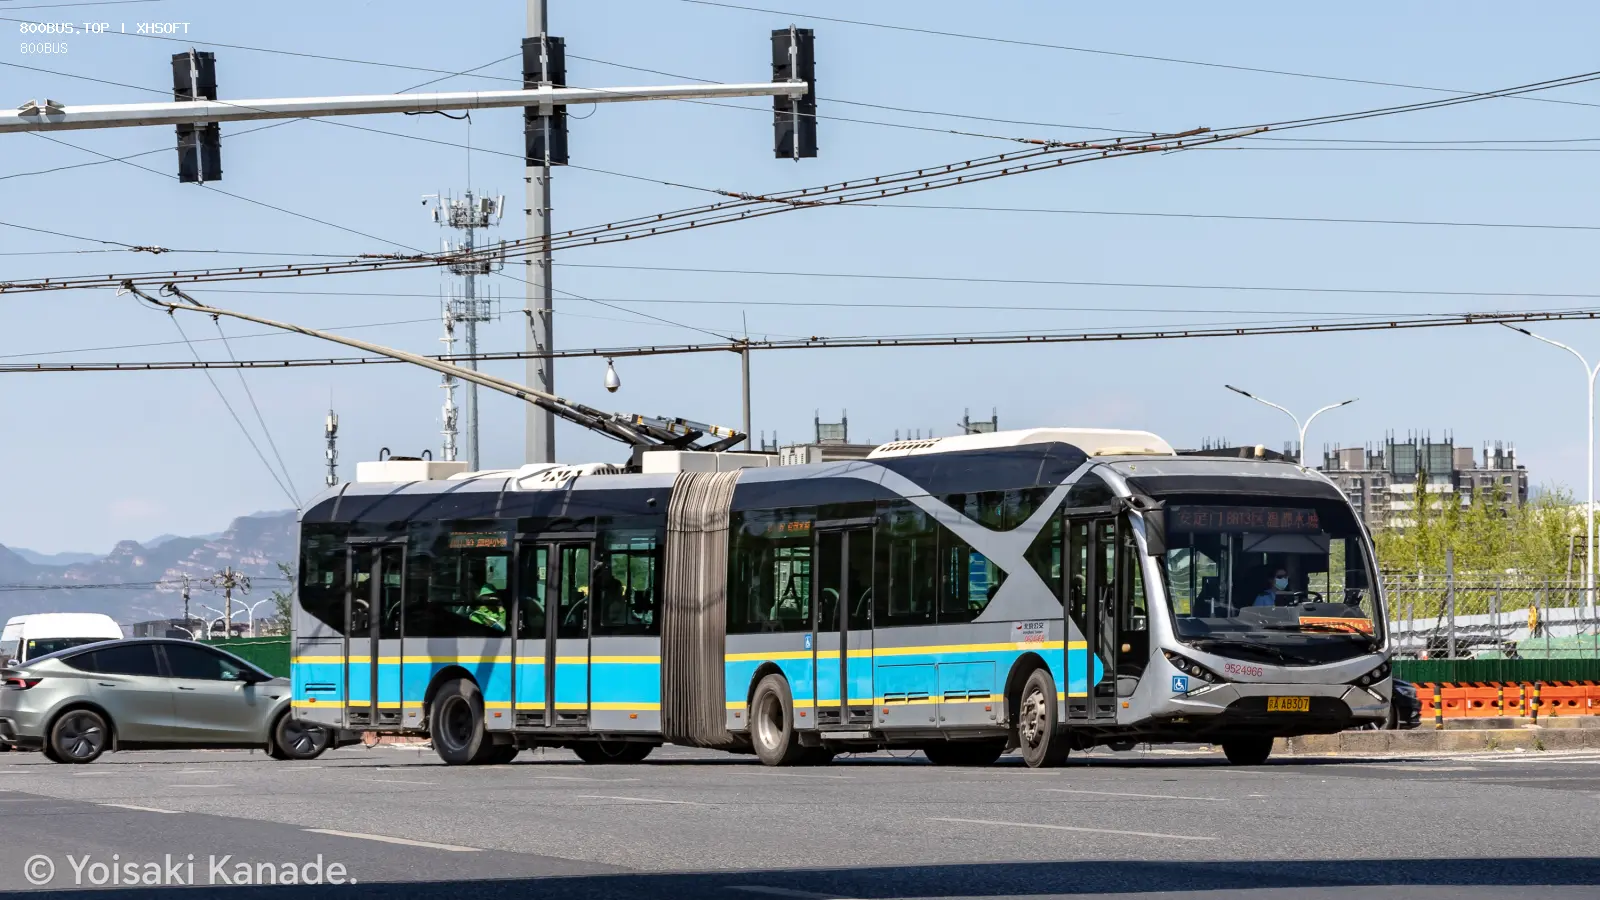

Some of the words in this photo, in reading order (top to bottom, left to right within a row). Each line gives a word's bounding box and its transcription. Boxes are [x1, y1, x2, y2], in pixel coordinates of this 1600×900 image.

[1178, 510, 1223, 528] 安定门
[1224, 663, 1263, 677] 9524966
[1281, 698, 1309, 710] AB307
